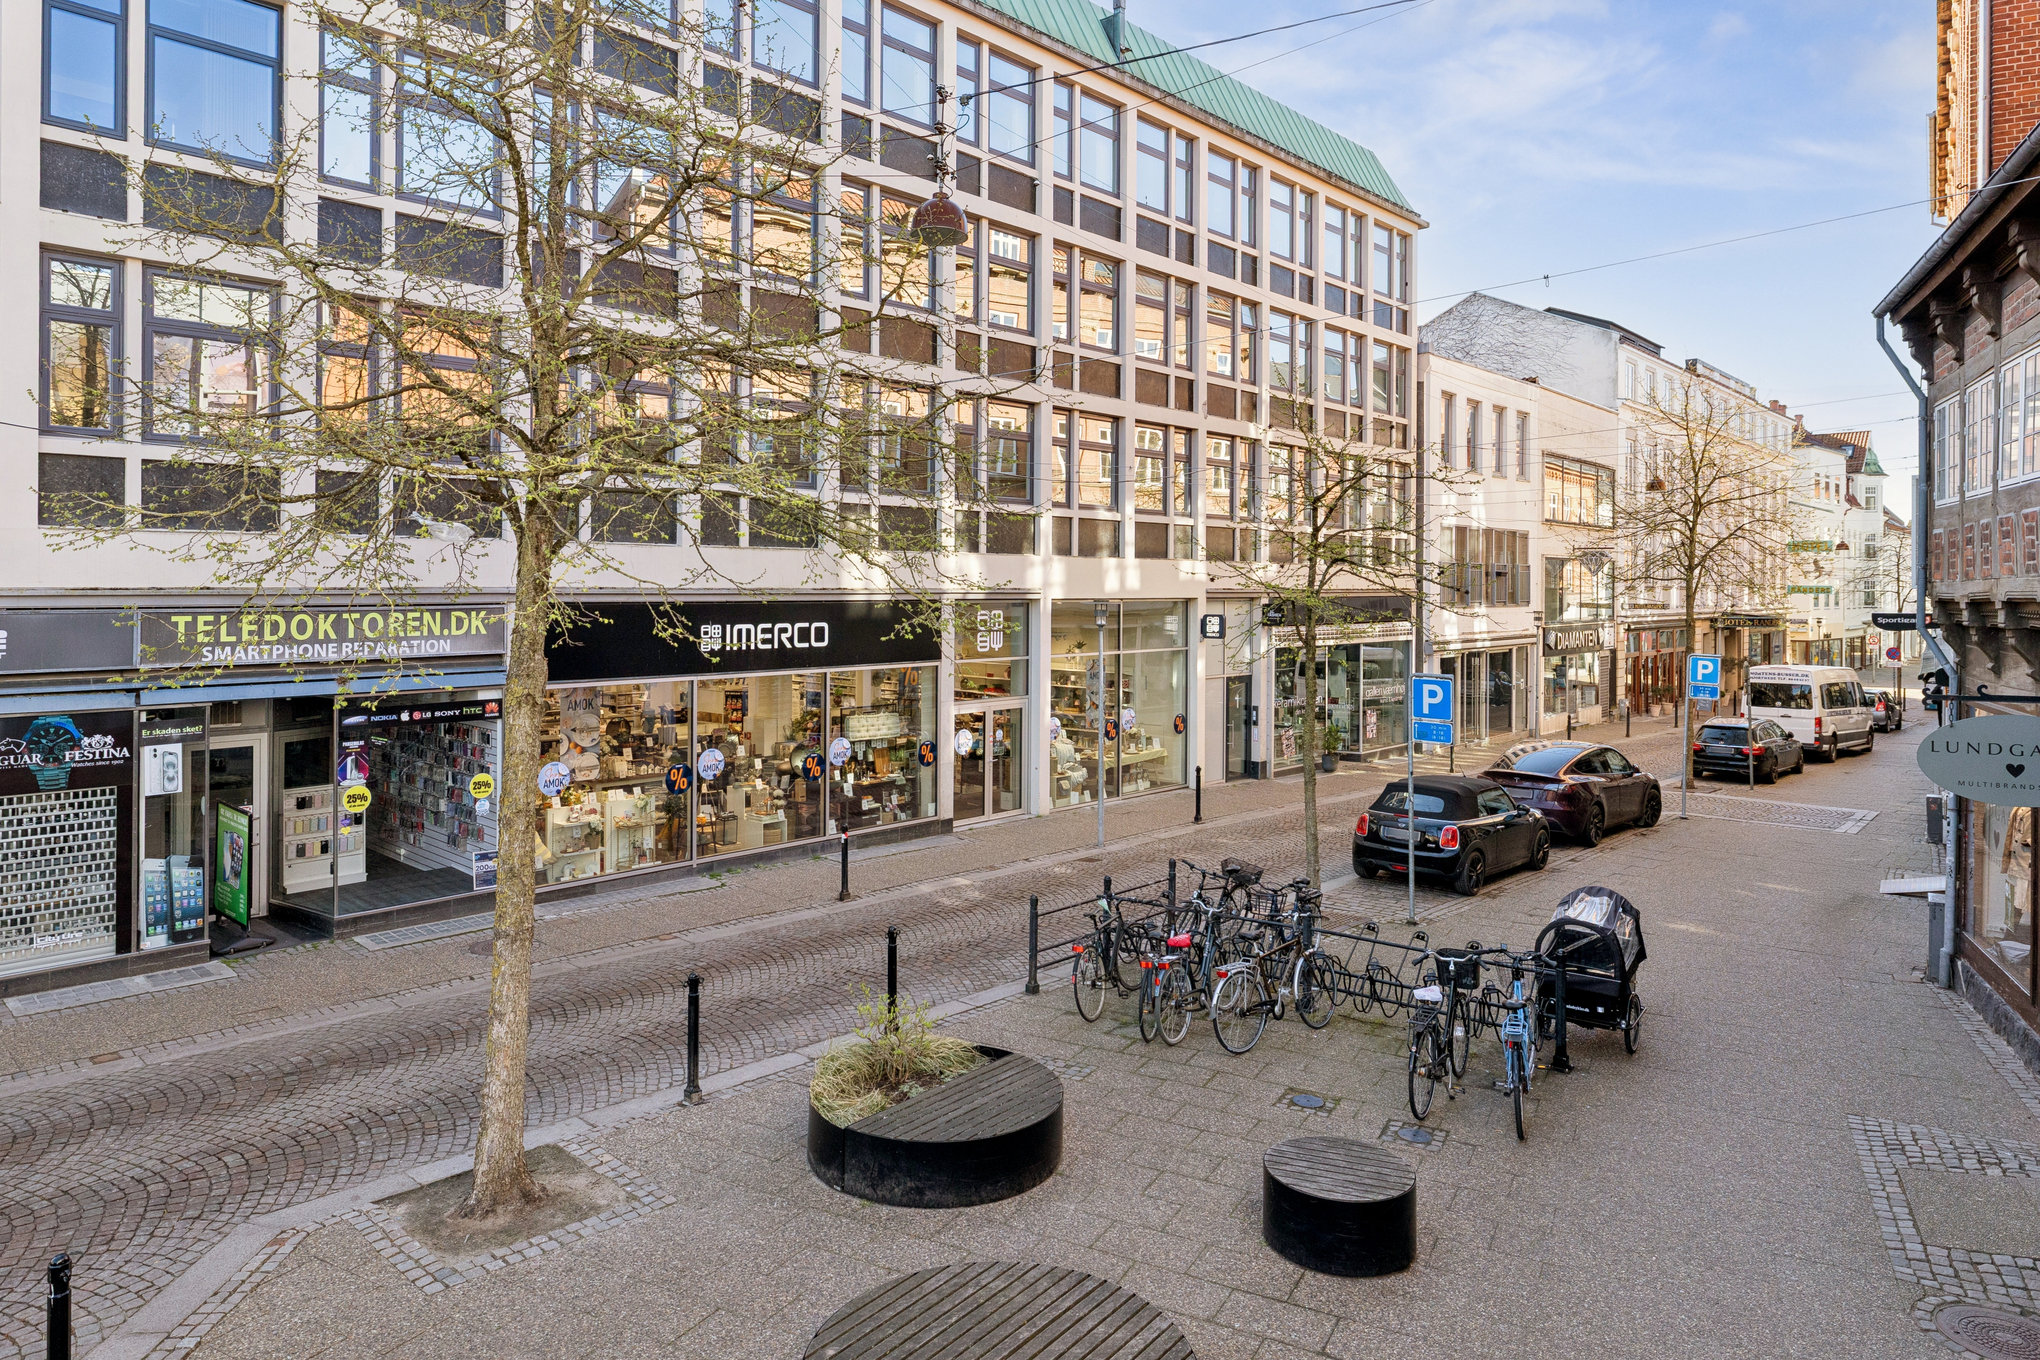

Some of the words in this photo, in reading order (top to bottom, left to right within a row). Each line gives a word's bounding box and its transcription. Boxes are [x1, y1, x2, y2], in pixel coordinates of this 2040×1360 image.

[1877, 616, 1917, 624] Sportiga
[725, 621, 829, 651] IMERCO
[1557, 628, 1598, 650] DIAMANTEN
[201, 642, 338, 662] SMARTPHONE
[341, 638, 451, 657] REPARATION
[1697, 660, 1714, 681] P
[567, 698, 595, 712] AMOK
[1422, 683, 1444, 715] P
[370, 714, 399, 722] NOKIA
[434, 709, 462, 718] SONY
[152, 727, 181, 735] skaden
[182, 725, 203, 733] sket?
[64, 746, 131, 762] FESTINA
[832, 750, 848, 761] AMOK
[1930, 740, 2040, 758] LUNDGA
[0, 753, 45, 766] GUAR
[702, 761, 721, 773] AMOK
[472, 780, 492, 791] 25%
[543, 777, 565, 789] AMOK
[346, 792, 369, 805] 25%
